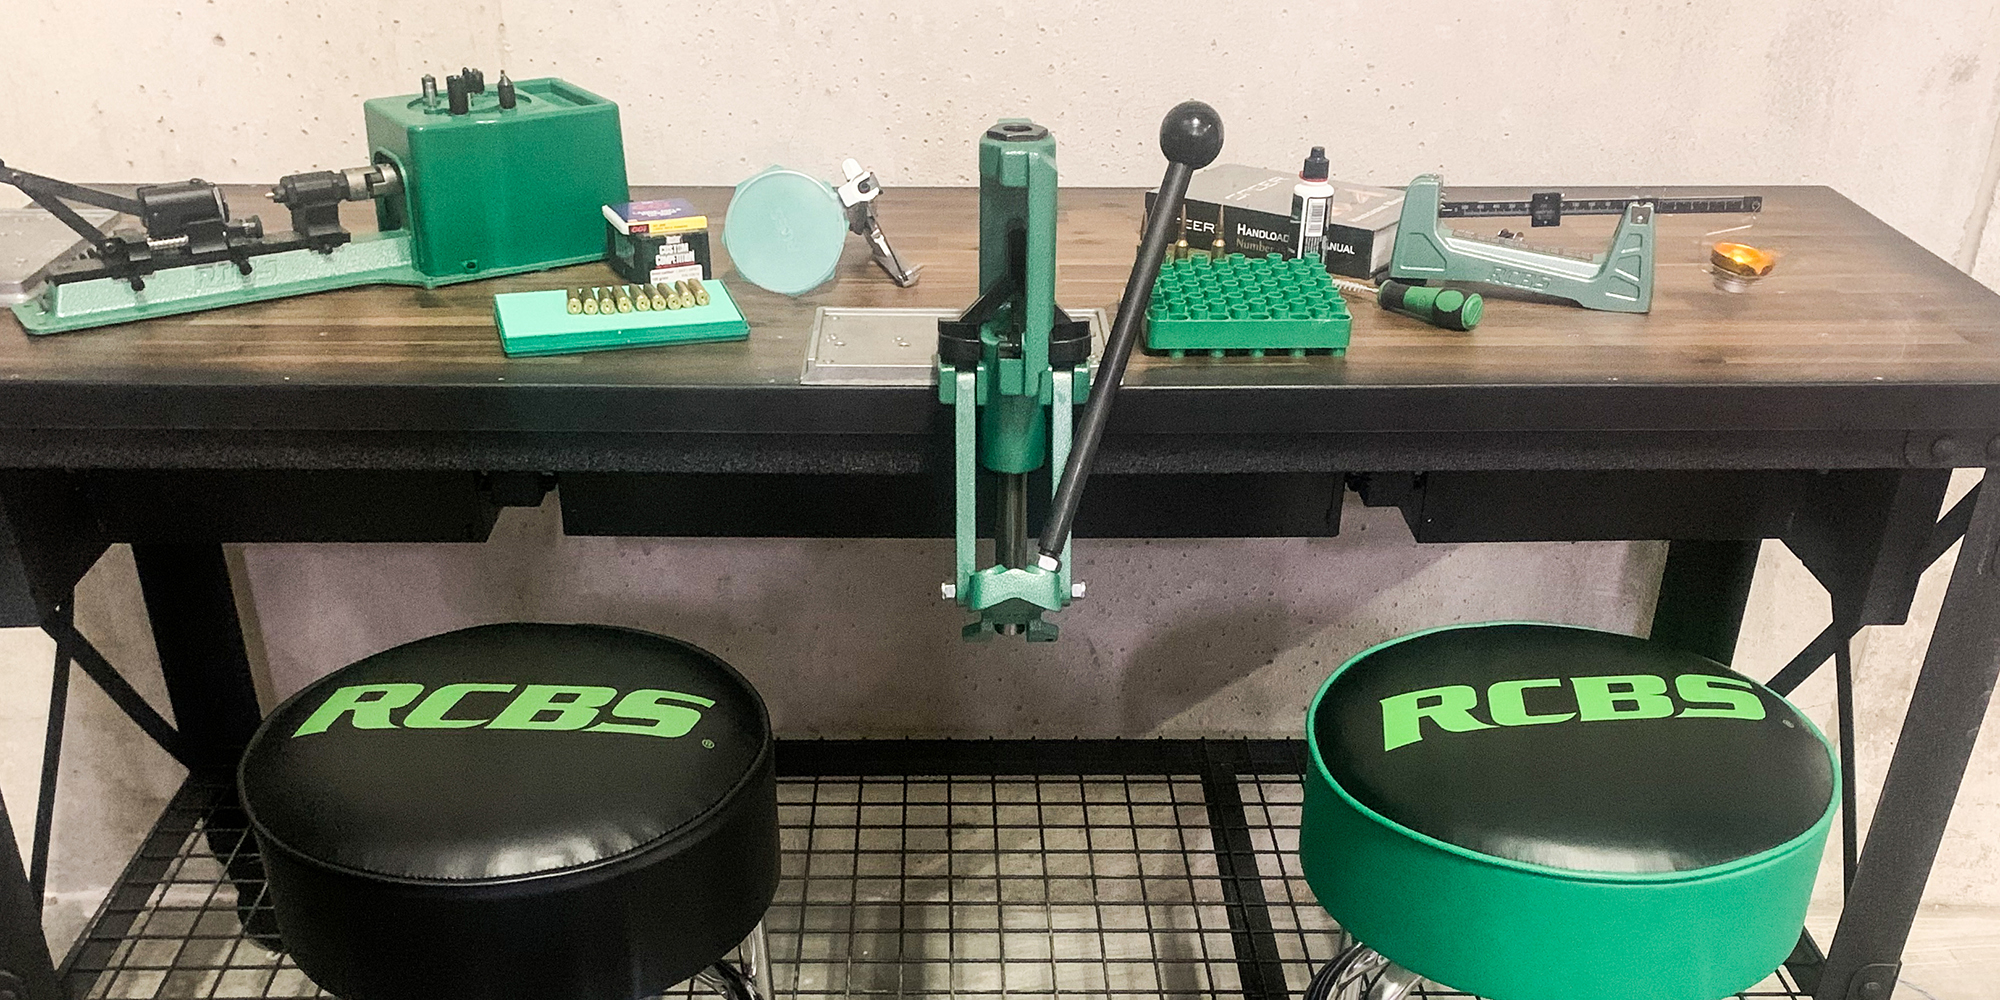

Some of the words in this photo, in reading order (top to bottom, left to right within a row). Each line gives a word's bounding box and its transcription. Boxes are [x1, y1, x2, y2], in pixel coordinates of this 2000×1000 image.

[659, 242, 689, 255] CUSTOM
[1237, 222, 1290, 243] HANDLOAD
[1327, 241, 1356, 255] NUAL
[1485, 266, 1551, 292] RCBS
[291, 683, 716, 738] RCBS
[1379, 674, 1766, 752] RCBS
